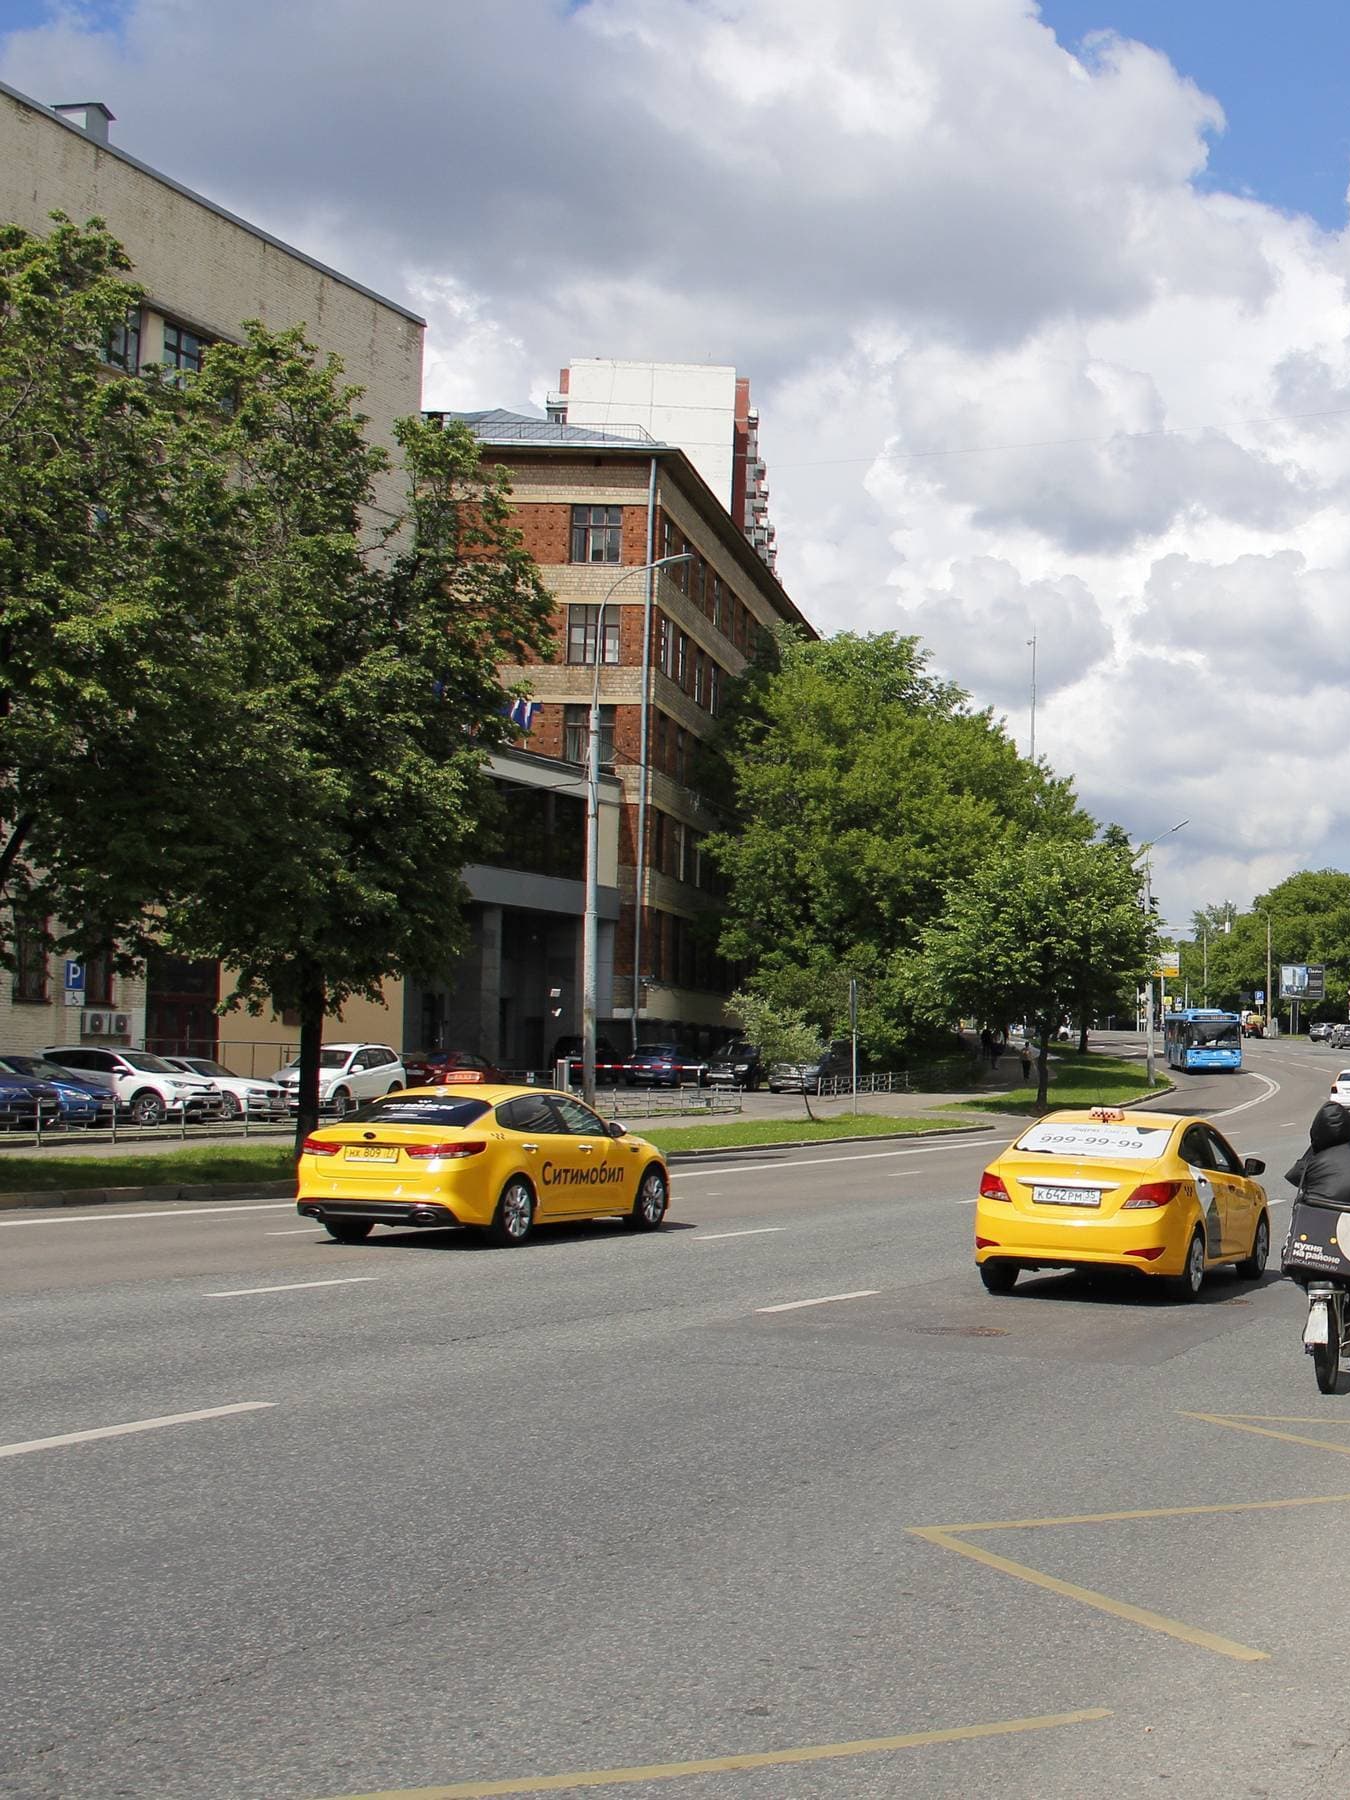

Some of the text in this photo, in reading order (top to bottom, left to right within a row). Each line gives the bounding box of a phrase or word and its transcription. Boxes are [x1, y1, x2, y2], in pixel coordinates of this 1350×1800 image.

[1039, 1135, 1144, 1150] 999-99-99
[542, 1160, 624, 1185] Ситимобил
[1294, 1241, 1323, 1253] кухня
[1292, 1249, 1340, 1264] на районе
